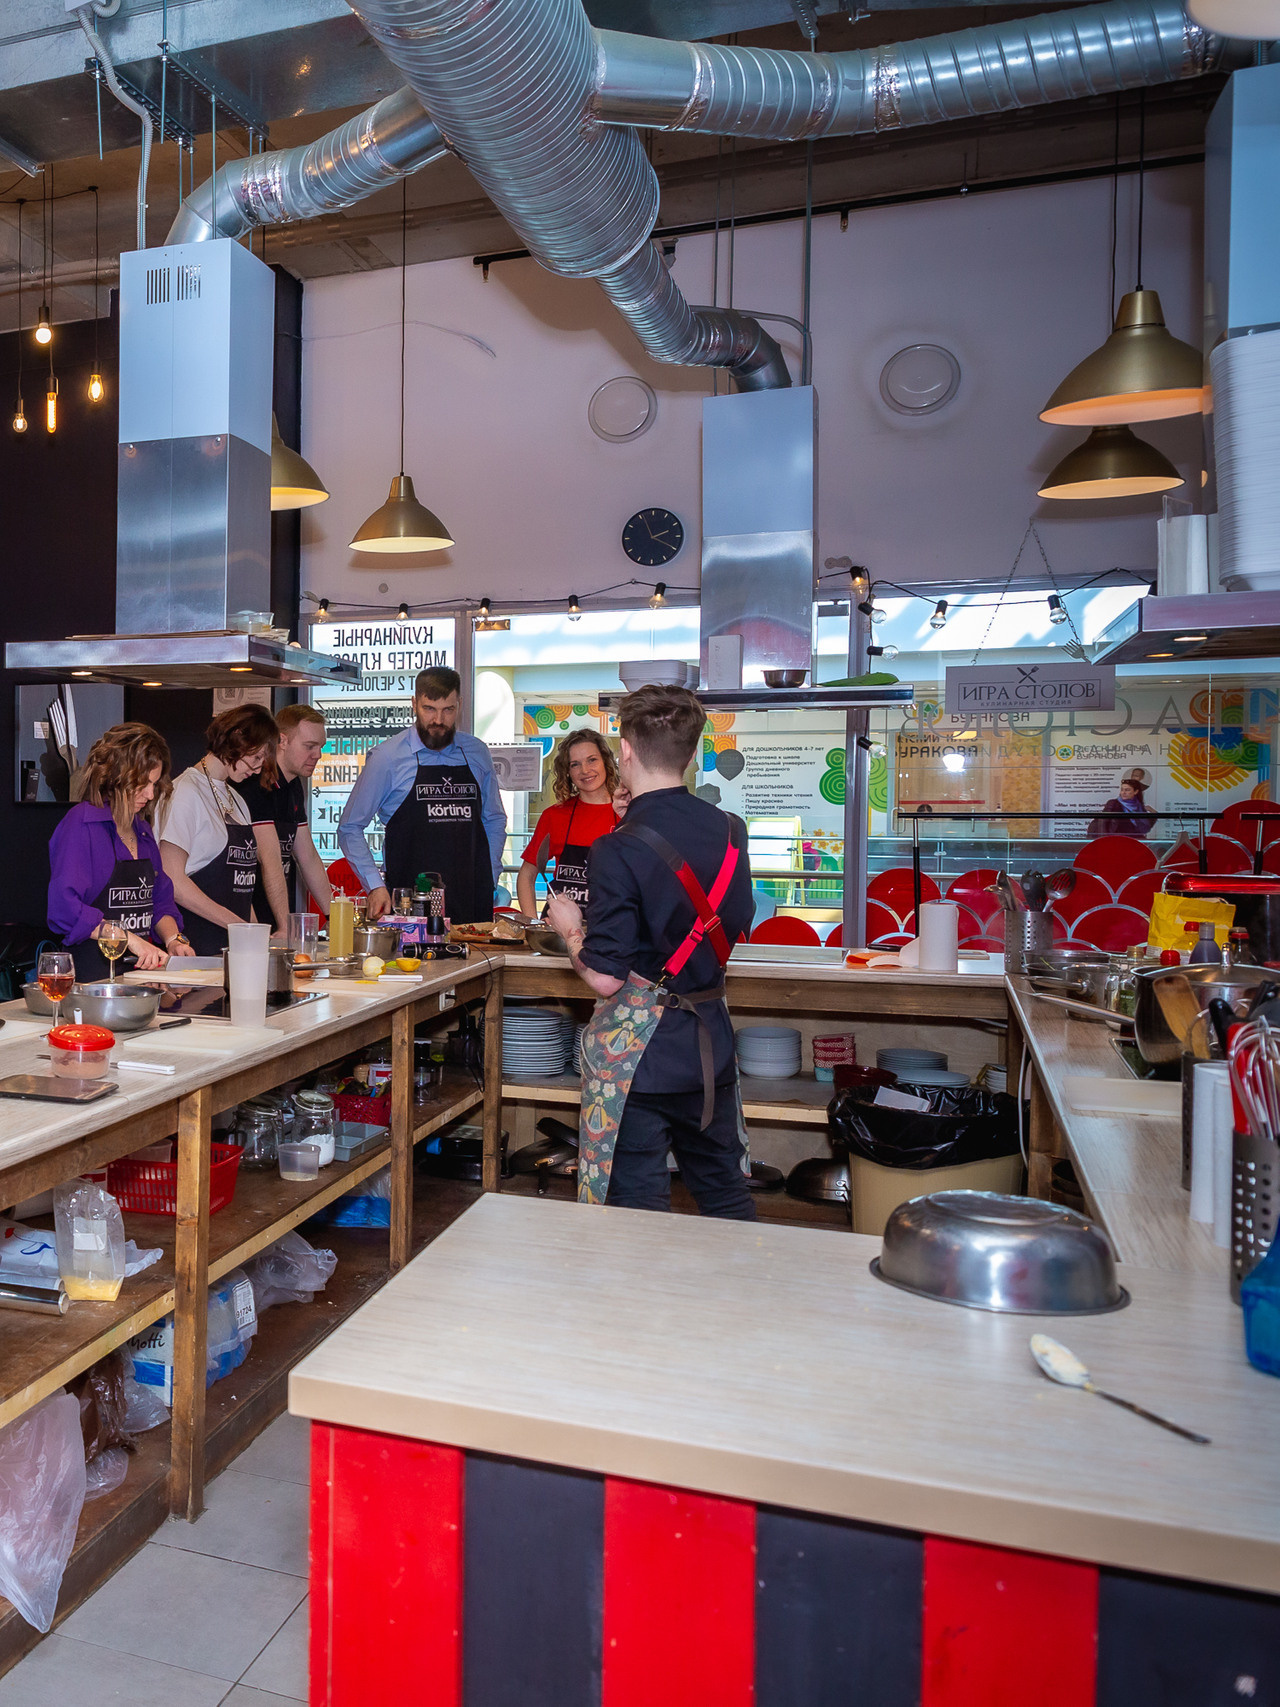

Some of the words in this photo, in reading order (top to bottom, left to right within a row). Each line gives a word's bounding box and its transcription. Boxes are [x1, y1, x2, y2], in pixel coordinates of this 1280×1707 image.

[963, 686, 1010, 700] ИГРА
[1015, 683, 1095, 699] СТОЛОВ
[427, 804, 472, 818] körting
